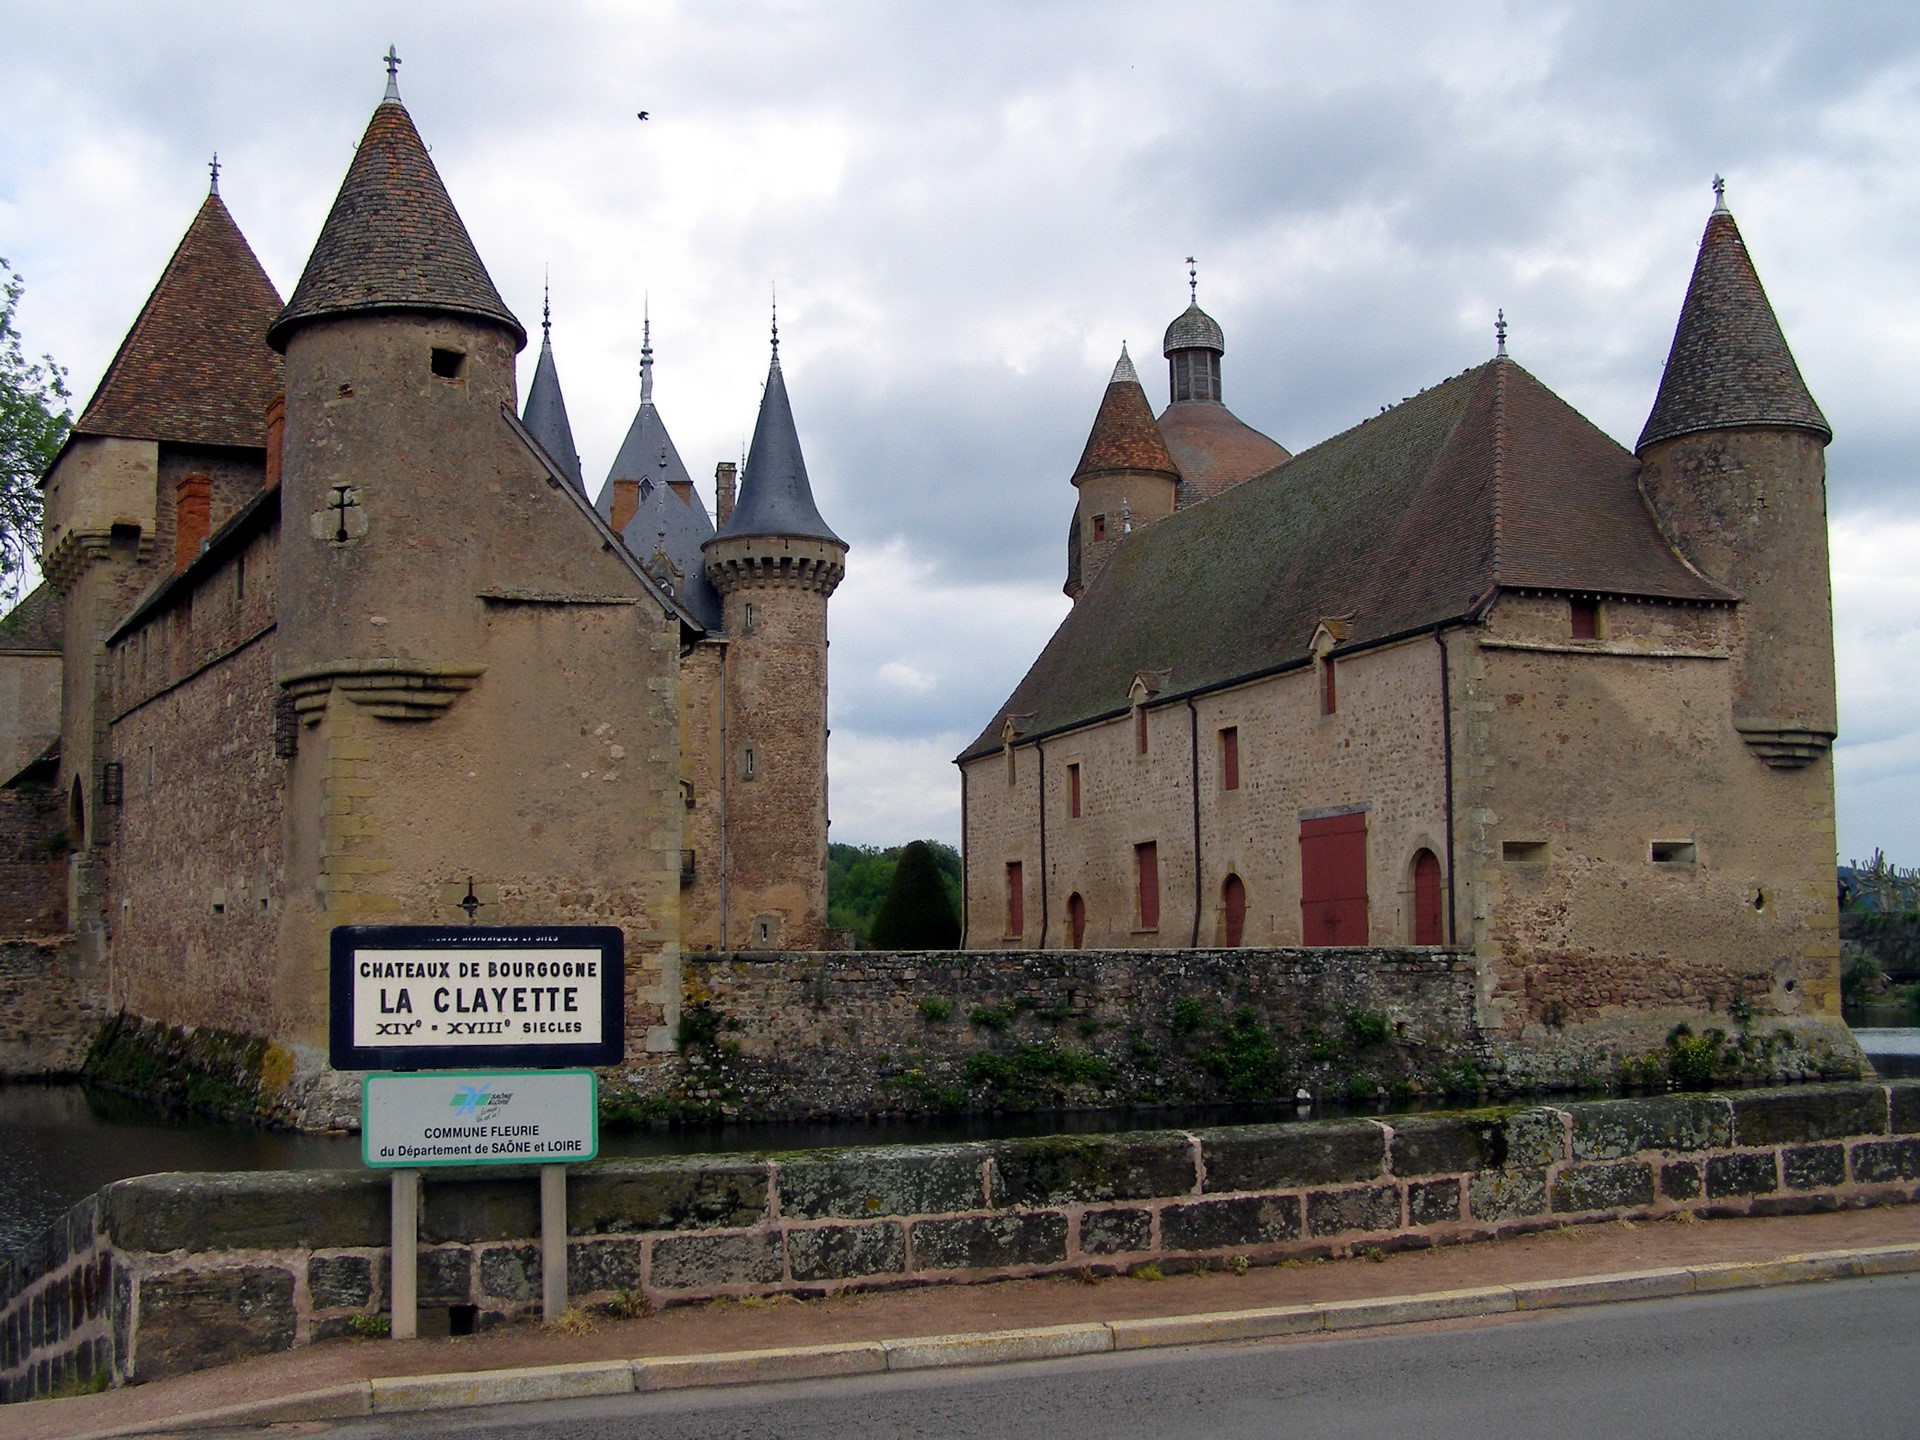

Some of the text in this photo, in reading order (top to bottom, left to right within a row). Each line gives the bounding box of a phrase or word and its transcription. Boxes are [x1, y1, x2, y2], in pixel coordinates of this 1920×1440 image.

[360, 962, 597, 978] CHATEAUX DE BOURGOGNE
[380, 987, 579, 1014] LA CLAYETTE
[522, 1022, 582, 1033] SIECLES
[424, 1125, 540, 1139] COMMUNE FLEURIE
[380, 1139, 582, 1158] du Département de SAÔNE et LOIRE
